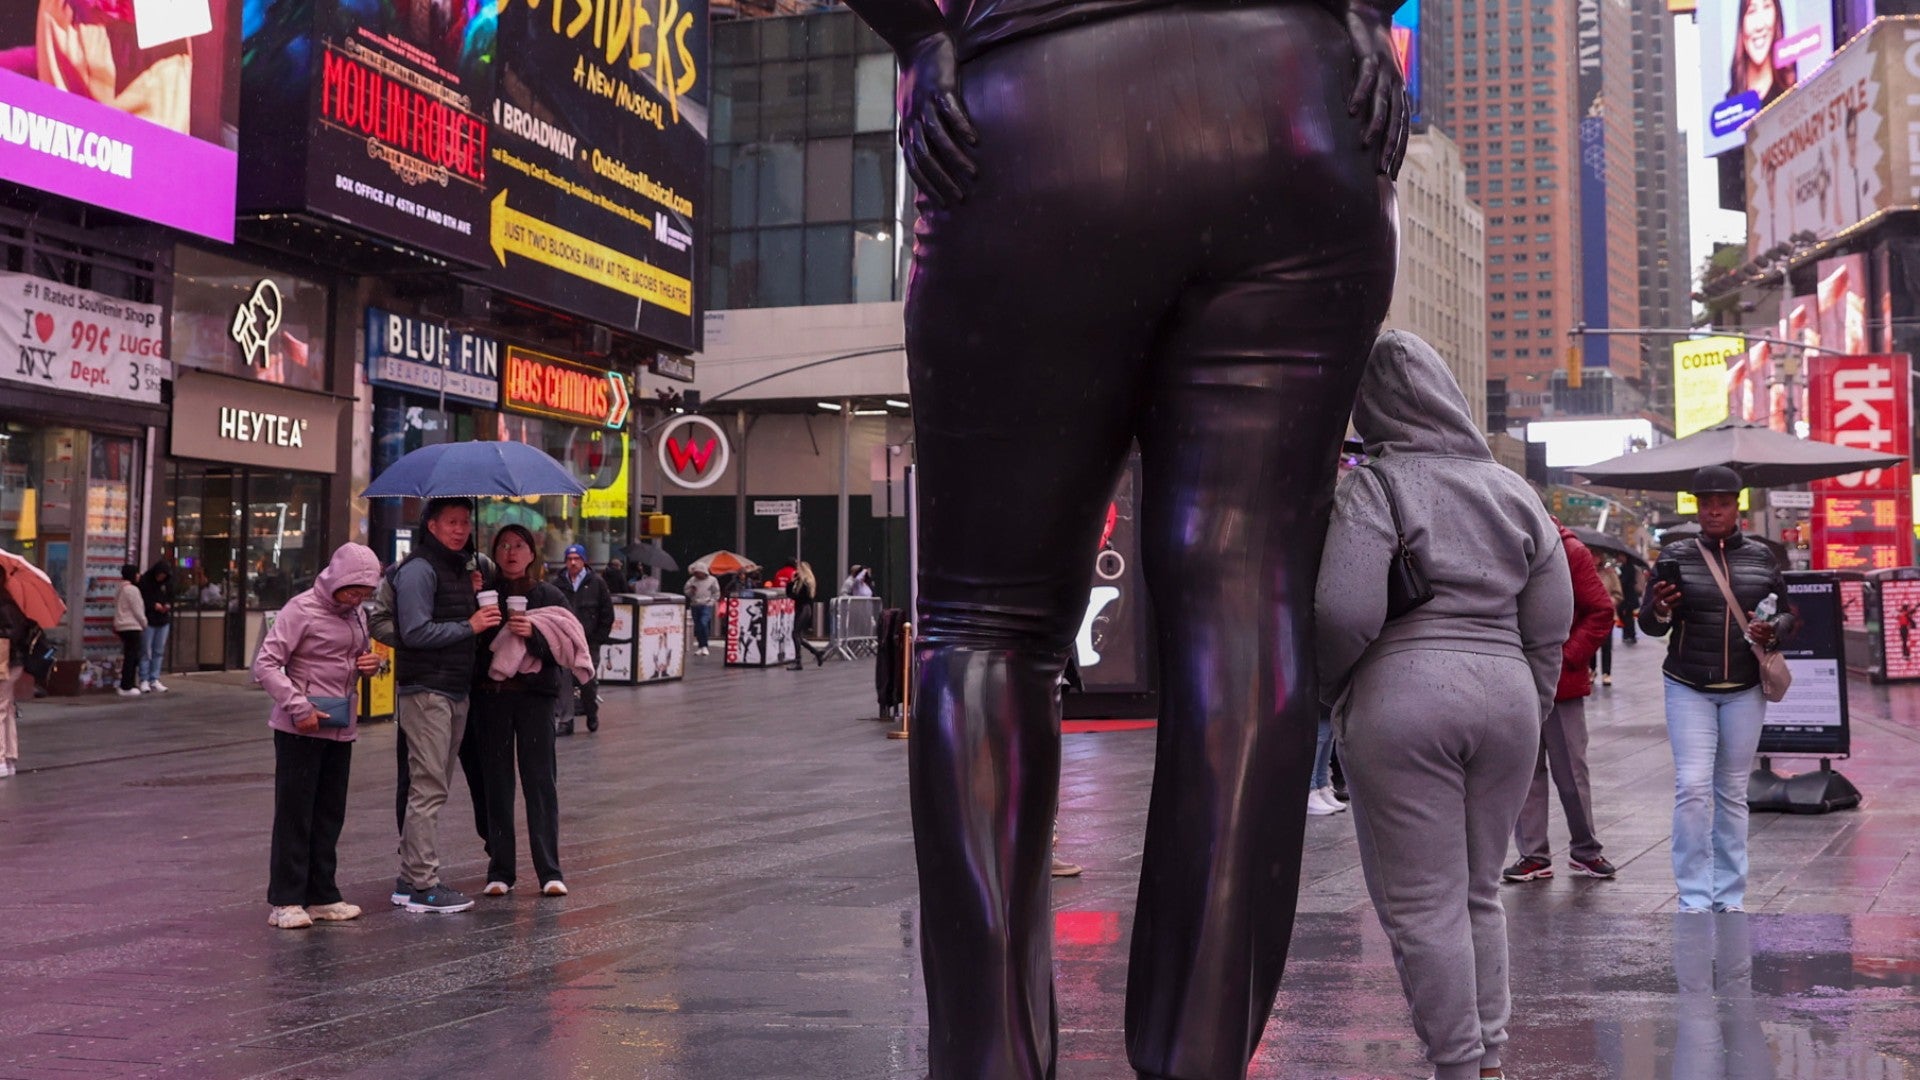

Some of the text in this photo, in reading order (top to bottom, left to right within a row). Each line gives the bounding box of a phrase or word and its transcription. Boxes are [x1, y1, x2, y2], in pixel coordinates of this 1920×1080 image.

[322, 50, 409, 148] MOULIN
[413, 93, 487, 181] ROUGE!
[573, 54, 665, 130] A NEW MUSICAL
[1761, 106, 1826, 178] MISSIONARY
[1829, 77, 1868, 132] STYLE
[503, 102, 577, 160] BROADWAY
[592, 149, 693, 219] OutsidersMusical.com
[336, 174, 353, 192] BOX
[355, 182, 383, 203] OFFICE
[384, 193, 396, 208] AT
[416, 205, 426, 218] ST
[427, 209, 442, 225] AND
[457, 218, 472, 235] AVE
[504, 222, 687, 304] JUST TWO BLOCKS AWAY AT THE JACOBS THEATRE
[22, 308, 34, 339] I
[71, 320, 110, 355] 99¢
[23, 282, 155, 328] #1 Rated Souvenir Shop
[16, 345, 57, 380] NY
[71, 360, 110, 388] Dept.
[129, 362, 140, 390] 3
[389, 314, 497, 377] BLUE FIN
[389, 361, 447, 387] SEAFOOD
[511, 357, 609, 419] DOS CAMINOS
[666, 437, 717, 474] W
[1787, 583, 1833, 593] MOMENT
